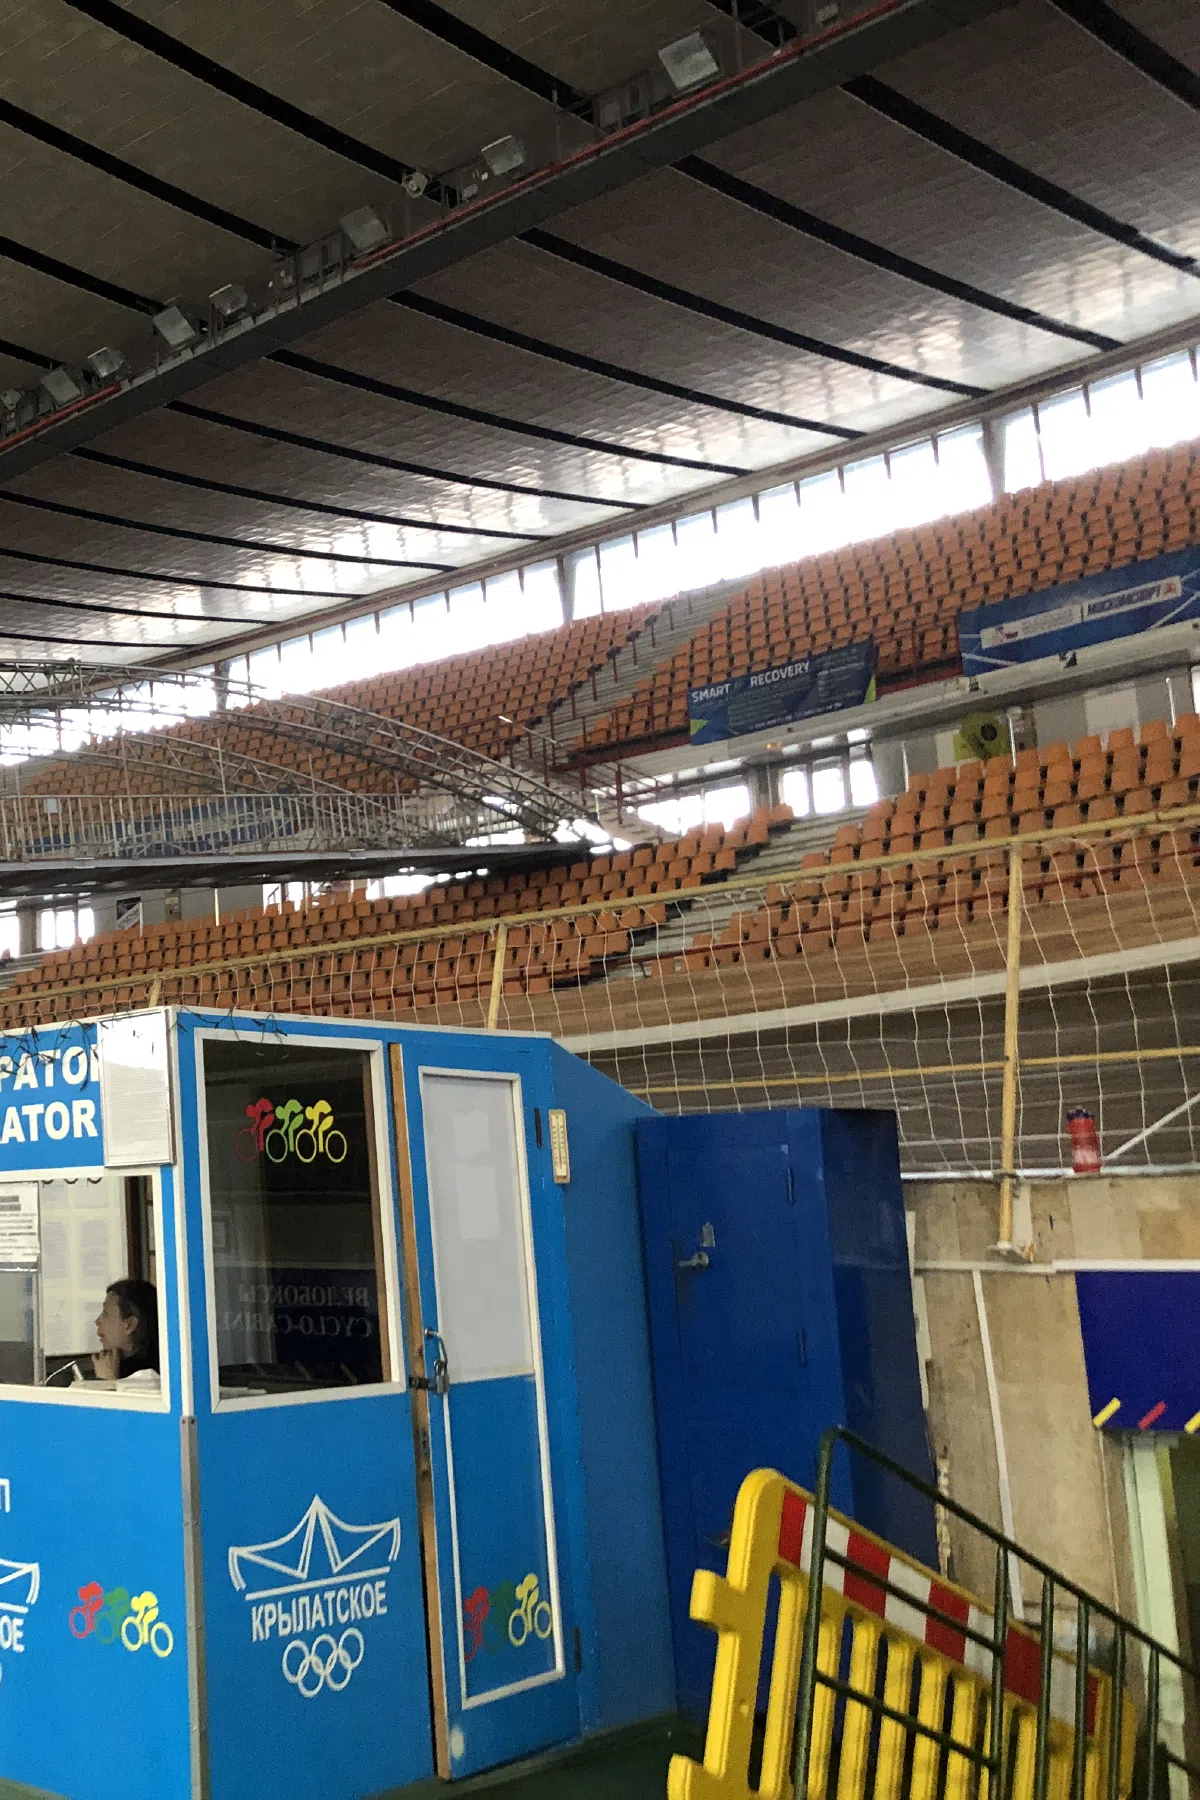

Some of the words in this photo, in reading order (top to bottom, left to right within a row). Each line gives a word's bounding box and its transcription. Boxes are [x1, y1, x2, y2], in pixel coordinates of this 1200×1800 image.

[691, 683, 730, 703] SMART
[750, 661, 810, 687] RECOVERY
[251, 1580, 388, 1644] КРЫЛАТСКОЕ
